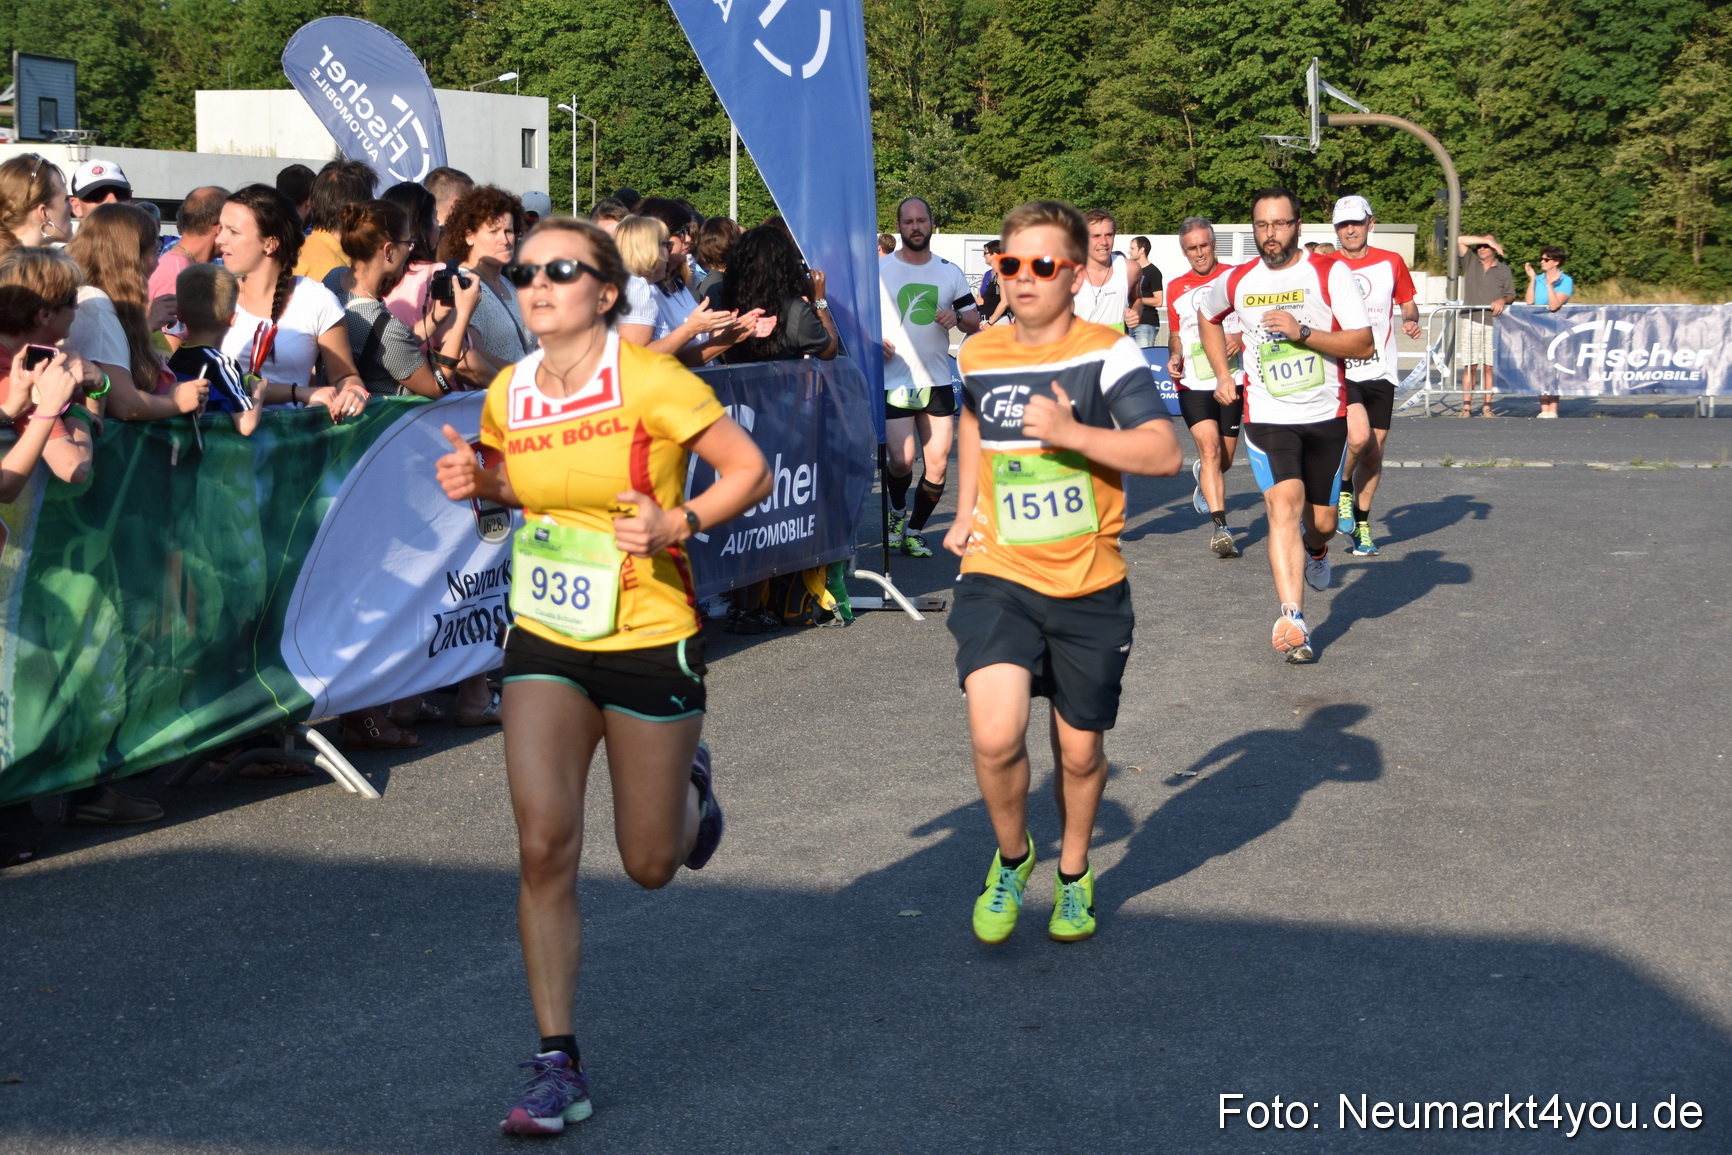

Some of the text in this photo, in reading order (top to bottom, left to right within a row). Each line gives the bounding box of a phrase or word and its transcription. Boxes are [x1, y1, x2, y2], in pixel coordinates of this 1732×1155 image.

[1246, 291, 1299, 306] ONLINE
[1576, 343, 1713, 367] Fischer
[434, 370, 449, 390] SONY
[1269, 356, 1315, 381] 1017
[1588, 371, 1701, 381] AUTOMOBILE
[508, 417, 629, 456] MAX BÖGL
[1003, 486, 1083, 520] 1518
[483, 517, 504, 535] 1628
[720, 514, 816, 557] AUTOMOBILE
[532, 566, 591, 611] 938
